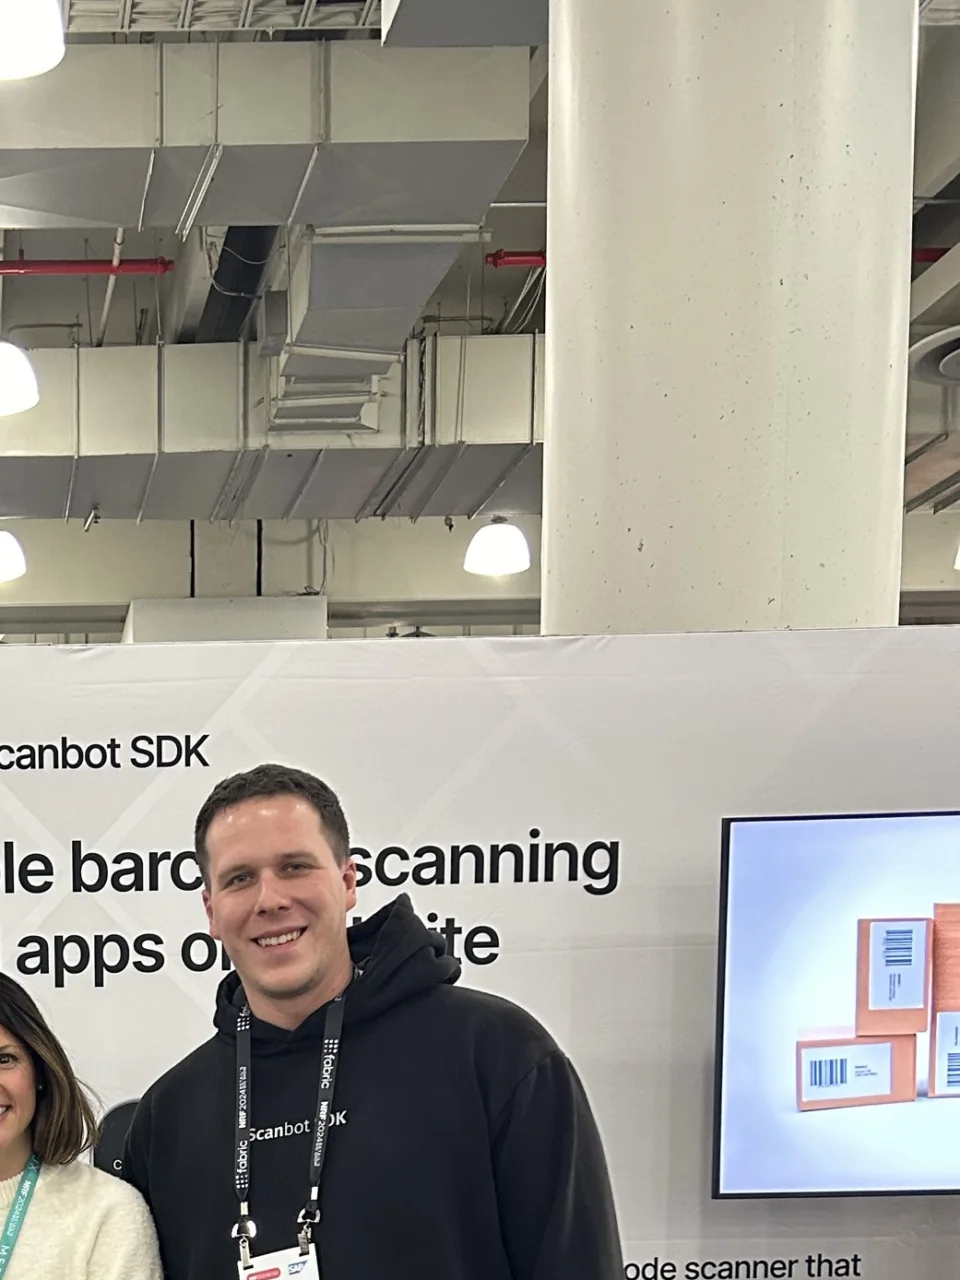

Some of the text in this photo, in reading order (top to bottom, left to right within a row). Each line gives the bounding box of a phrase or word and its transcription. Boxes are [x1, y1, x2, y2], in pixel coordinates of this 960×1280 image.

[130, 734, 210, 769] SDK
[71, 840, 203, 893] barc
[351, 828, 620, 895] scanning
[16, 932, 165, 988] apps
[321, 1054, 335, 1089] fabric
[249, 1119, 310, 1142] Scanbot
[236, 1140, 248, 1173] fabric
[624, 1253, 862, 1280] ode scanner that
